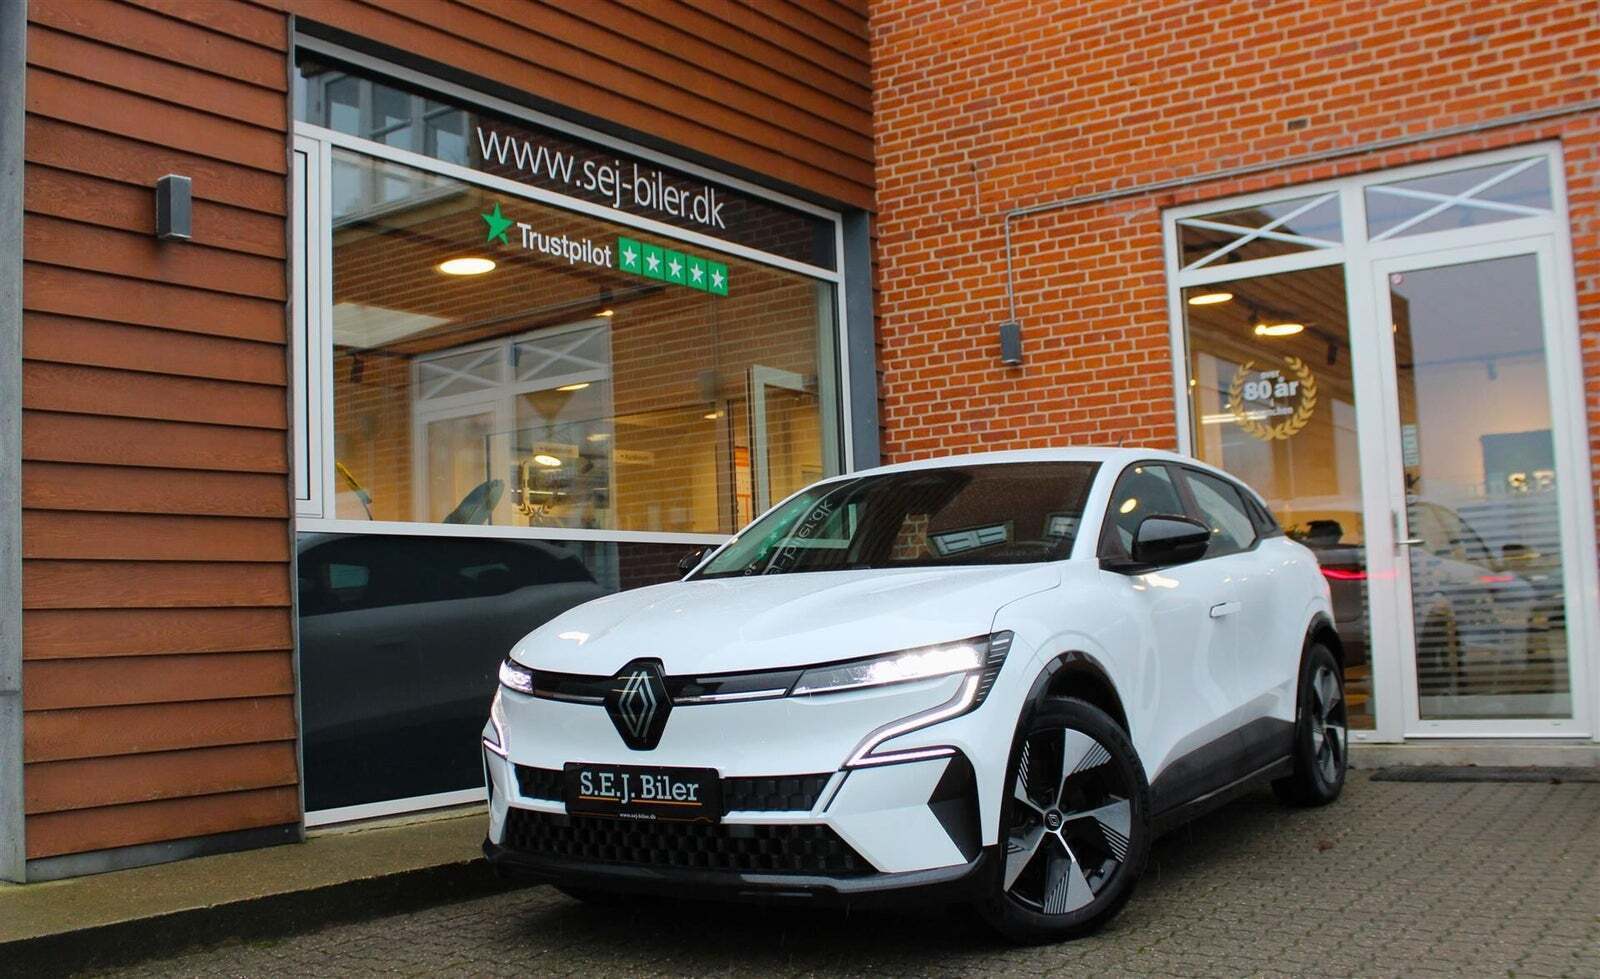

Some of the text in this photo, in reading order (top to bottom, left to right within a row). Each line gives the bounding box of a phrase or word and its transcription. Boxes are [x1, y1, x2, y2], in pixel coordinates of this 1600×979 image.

[477, 126, 726, 230] www.sej-biler.dk
[516, 222, 612, 268] Trustpilot
[1243, 375, 1299, 400] 80 år
[580, 771, 699, 803] S.E.J. Biler
